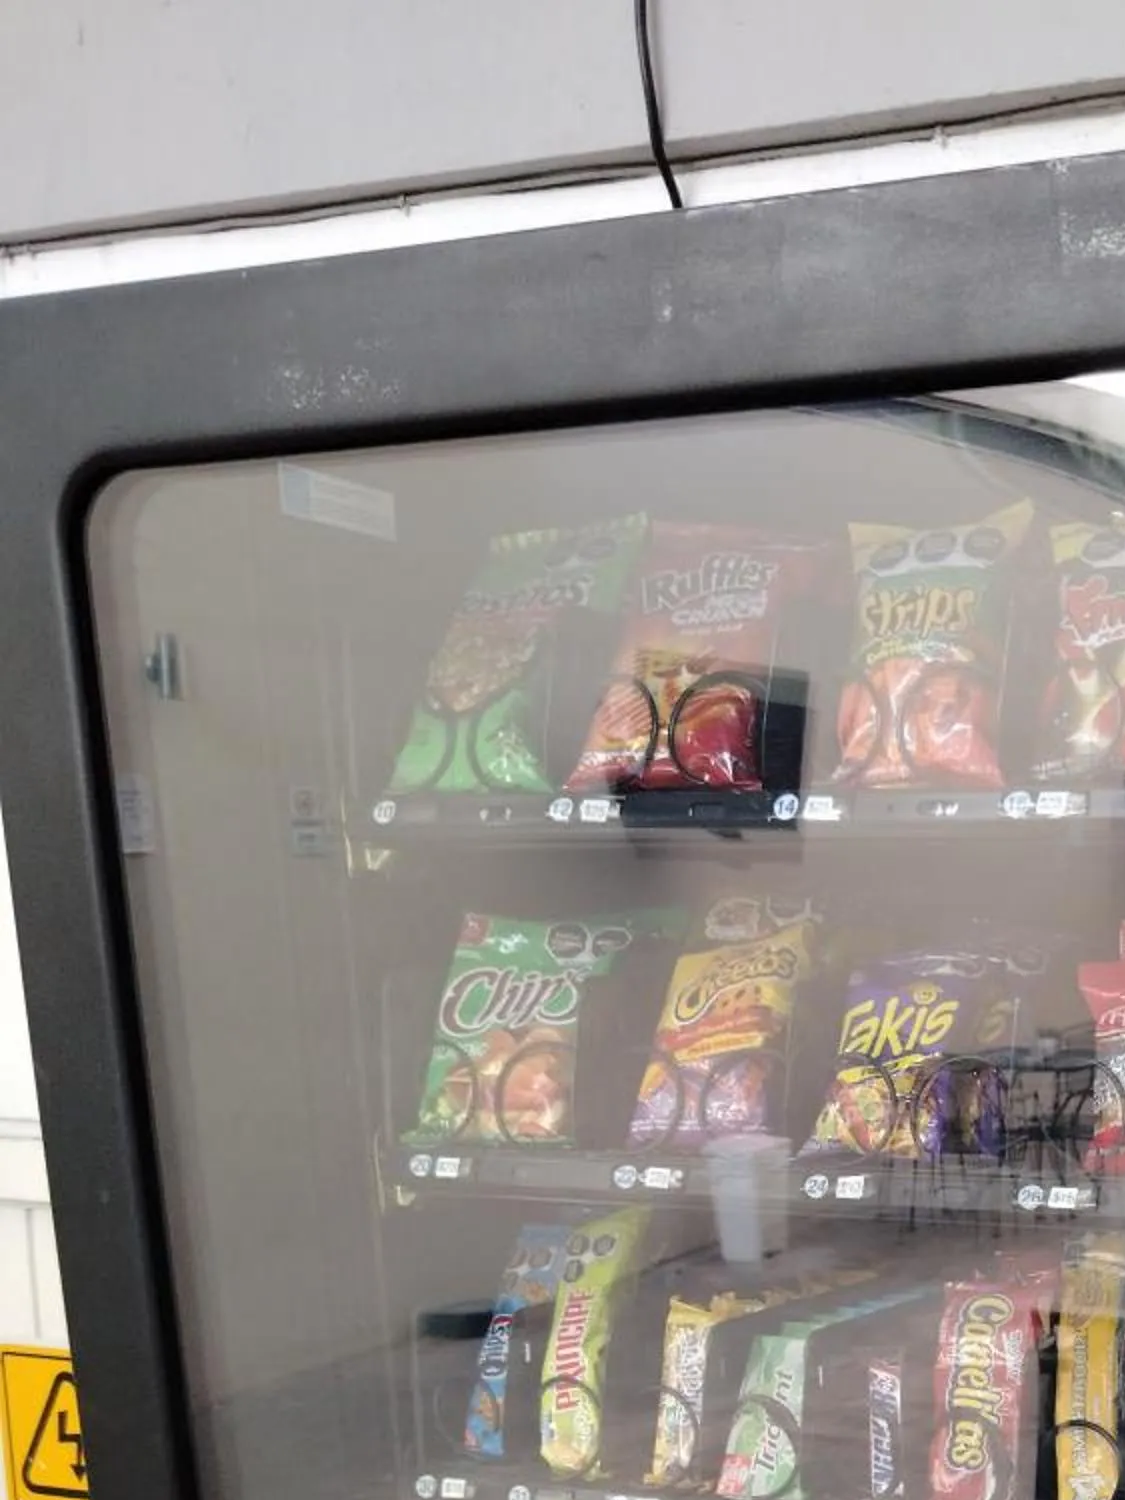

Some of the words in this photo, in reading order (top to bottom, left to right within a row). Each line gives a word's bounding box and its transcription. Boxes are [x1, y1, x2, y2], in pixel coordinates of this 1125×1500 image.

[778, 800, 797, 816] 14
[440, 966, 578, 1038] Chips
[838, 996, 960, 1058] Takis
[949, 1295, 1014, 1470] Canelias
